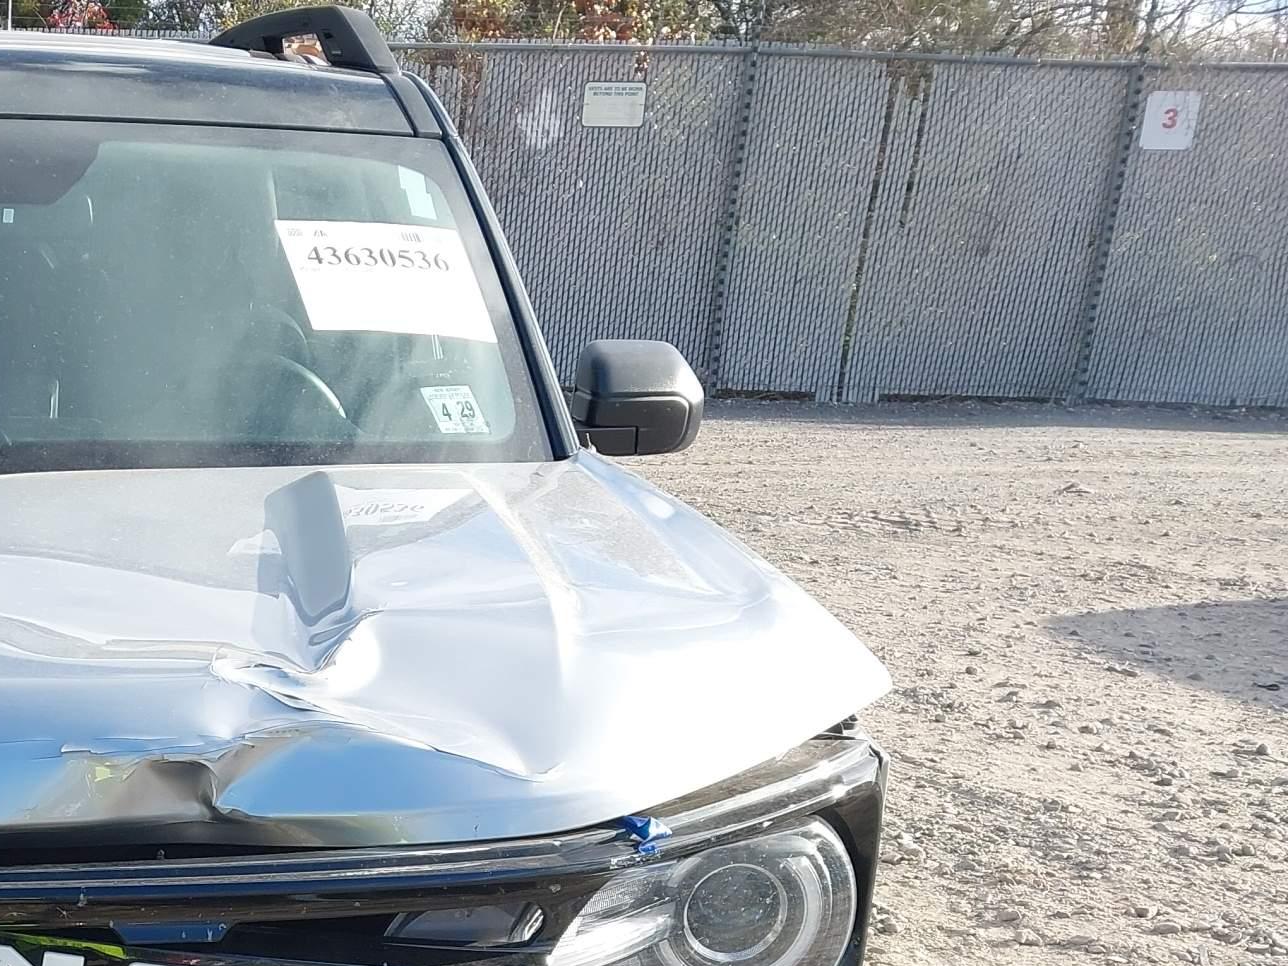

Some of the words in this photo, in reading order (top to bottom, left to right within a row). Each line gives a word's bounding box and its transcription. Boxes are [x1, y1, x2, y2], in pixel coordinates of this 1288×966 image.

[1162, 107, 1178, 129] 3
[307, 246, 450, 272] 43630536
[441, 402, 453, 421] 4
[456, 400, 476, 419] 29
